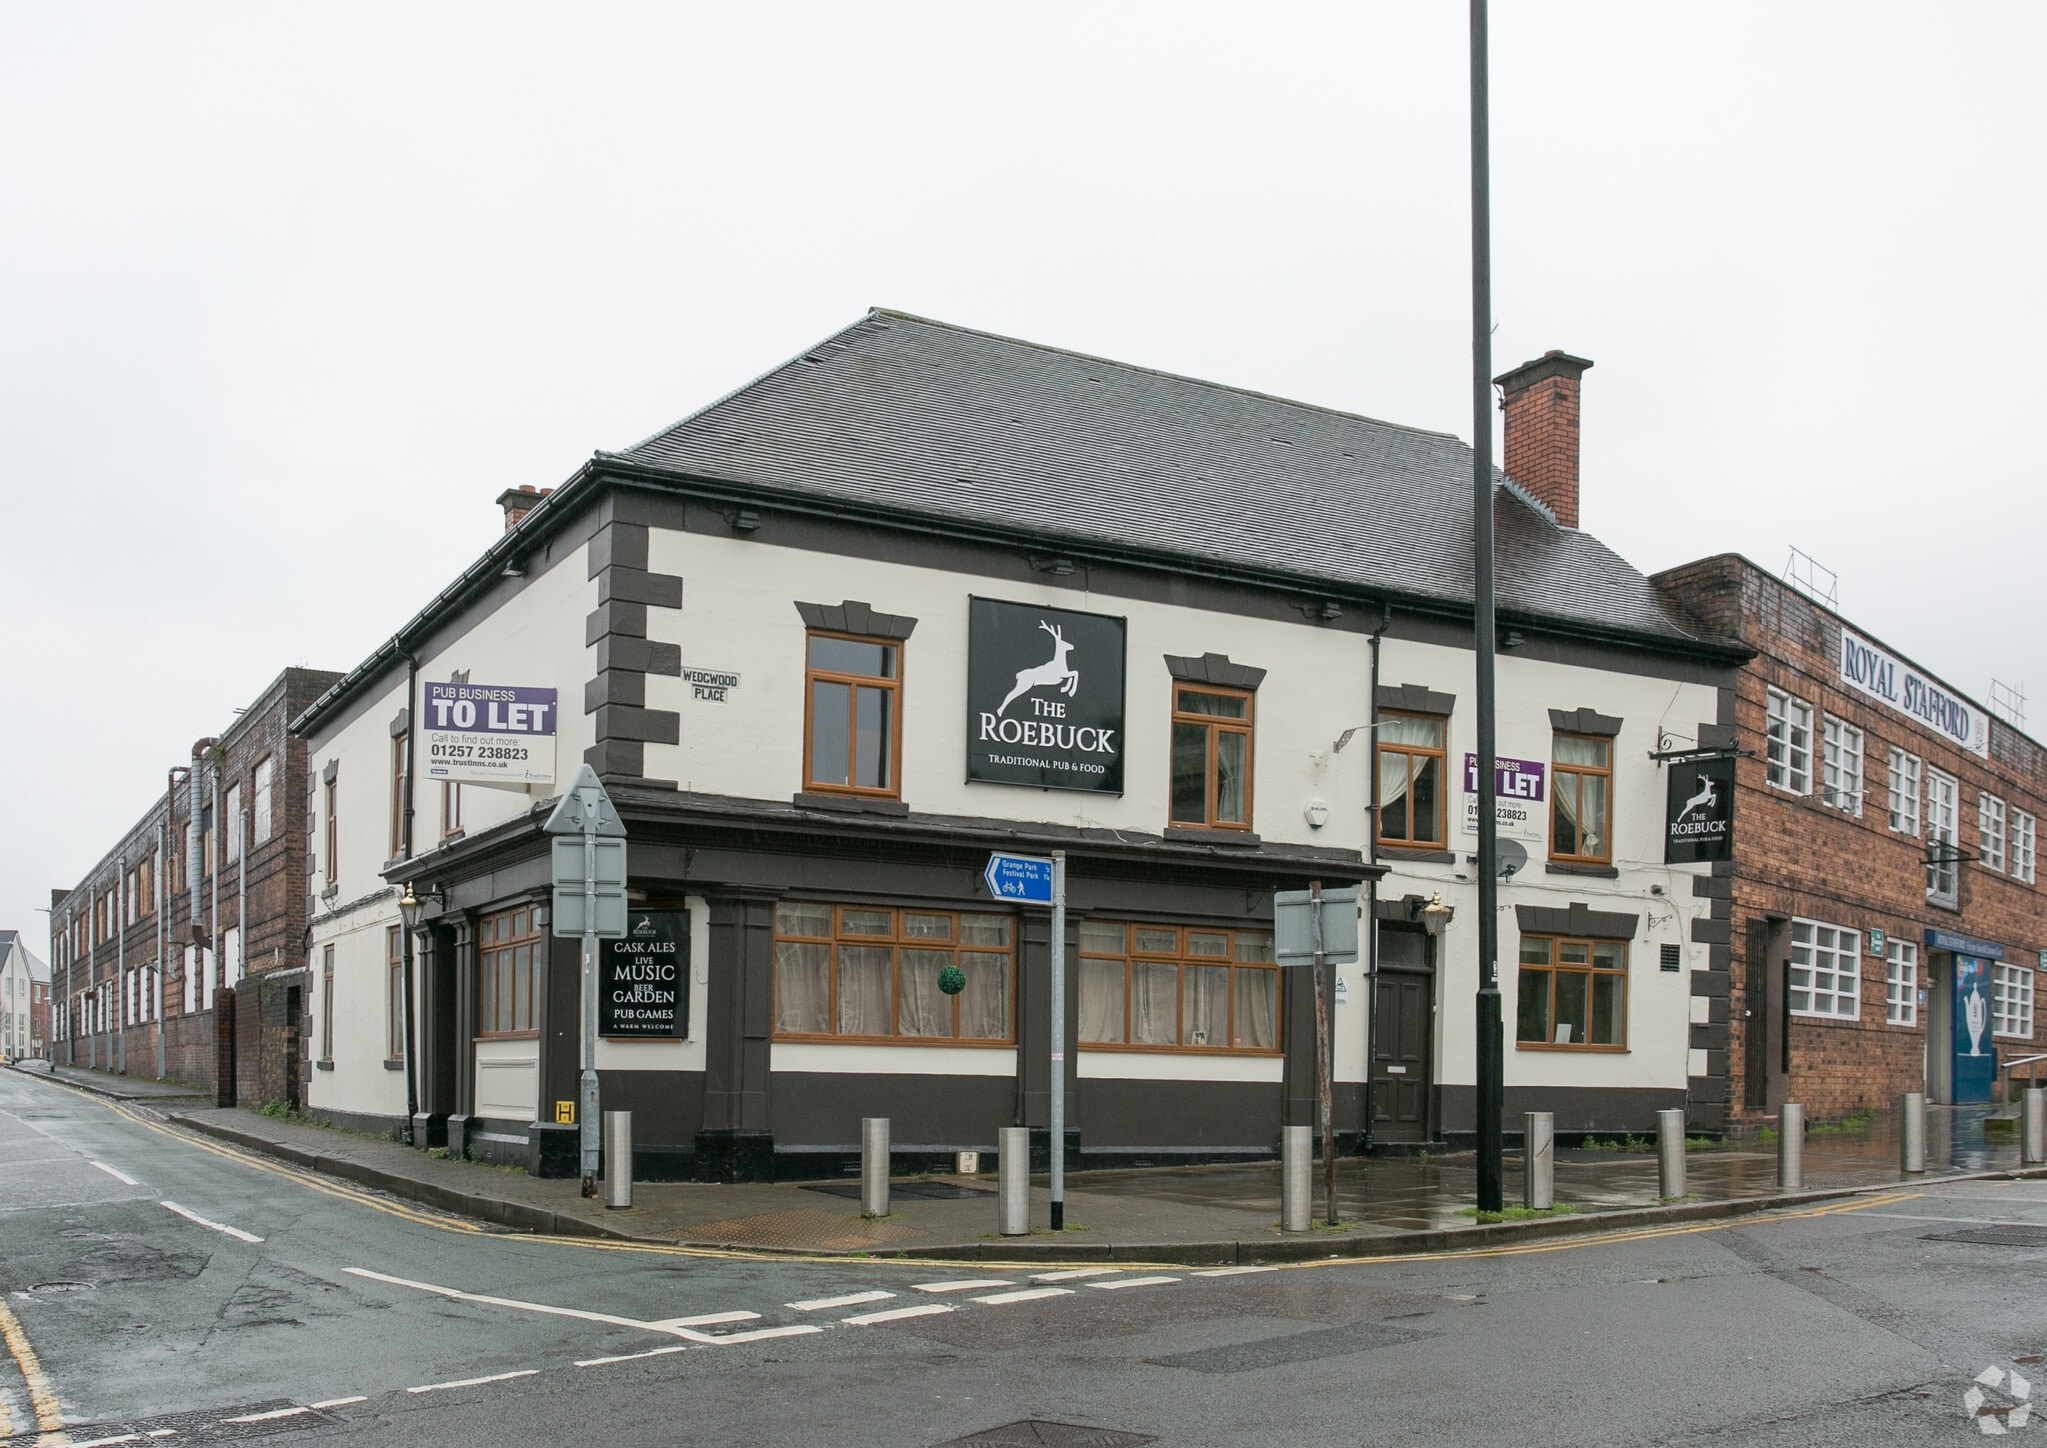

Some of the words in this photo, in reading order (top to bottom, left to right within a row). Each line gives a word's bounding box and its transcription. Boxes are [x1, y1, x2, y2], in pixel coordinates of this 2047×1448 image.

[433, 686, 456, 699] PUB
[460, 688, 515, 702] BUSINESS
[695, 688, 725, 702] PLACE
[1844, 637, 1899, 702] ROYAL
[1904, 673, 1969, 741] STAFFORD
[432, 698, 476, 728] TO
[488, 701, 549, 731] LET
[1030, 697, 1066, 718] THE
[431, 733, 448, 743] Call
[451, 734, 459, 744] to
[462, 734, 477, 745] find
[480, 736, 494, 745] out
[496, 738, 521, 747] more:
[979, 712, 1115, 754] ROEBUCK
[431, 744, 473, 757] 01257
[478, 746, 528, 760] 238823
[431, 758, 508, 768] www.trustinns.co.uk
[988, 754, 1050, 769] TRADITIONAL
[1053, 760, 1070, 771] PUB
[1072, 763, 1078, 771] &
[1080, 763, 1105, 774] FOOD
[1495, 760, 1520, 772] SINESS
[1503, 770, 1540, 798] LET
[1497, 808, 1527, 821] 238823
[1691, 813, 1706, 821] THE
[1671, 820, 1726, 835] ROEBUCK
[1003, 860, 1023, 870] Grange
[1025, 863, 1037, 871] Park
[1003, 869, 1024, 878] Festival
[614, 942, 645, 953] CASK
[647, 942, 676, 953] ALES
[635, 957, 654, 965] LIVE
[614, 965, 675, 981] MUSIC
[634, 984, 654, 992] BEER
[613, 990, 675, 1003] GARDEN
[614, 1009, 634, 1019] PUB
[636, 1009, 674, 1019] GAMES
